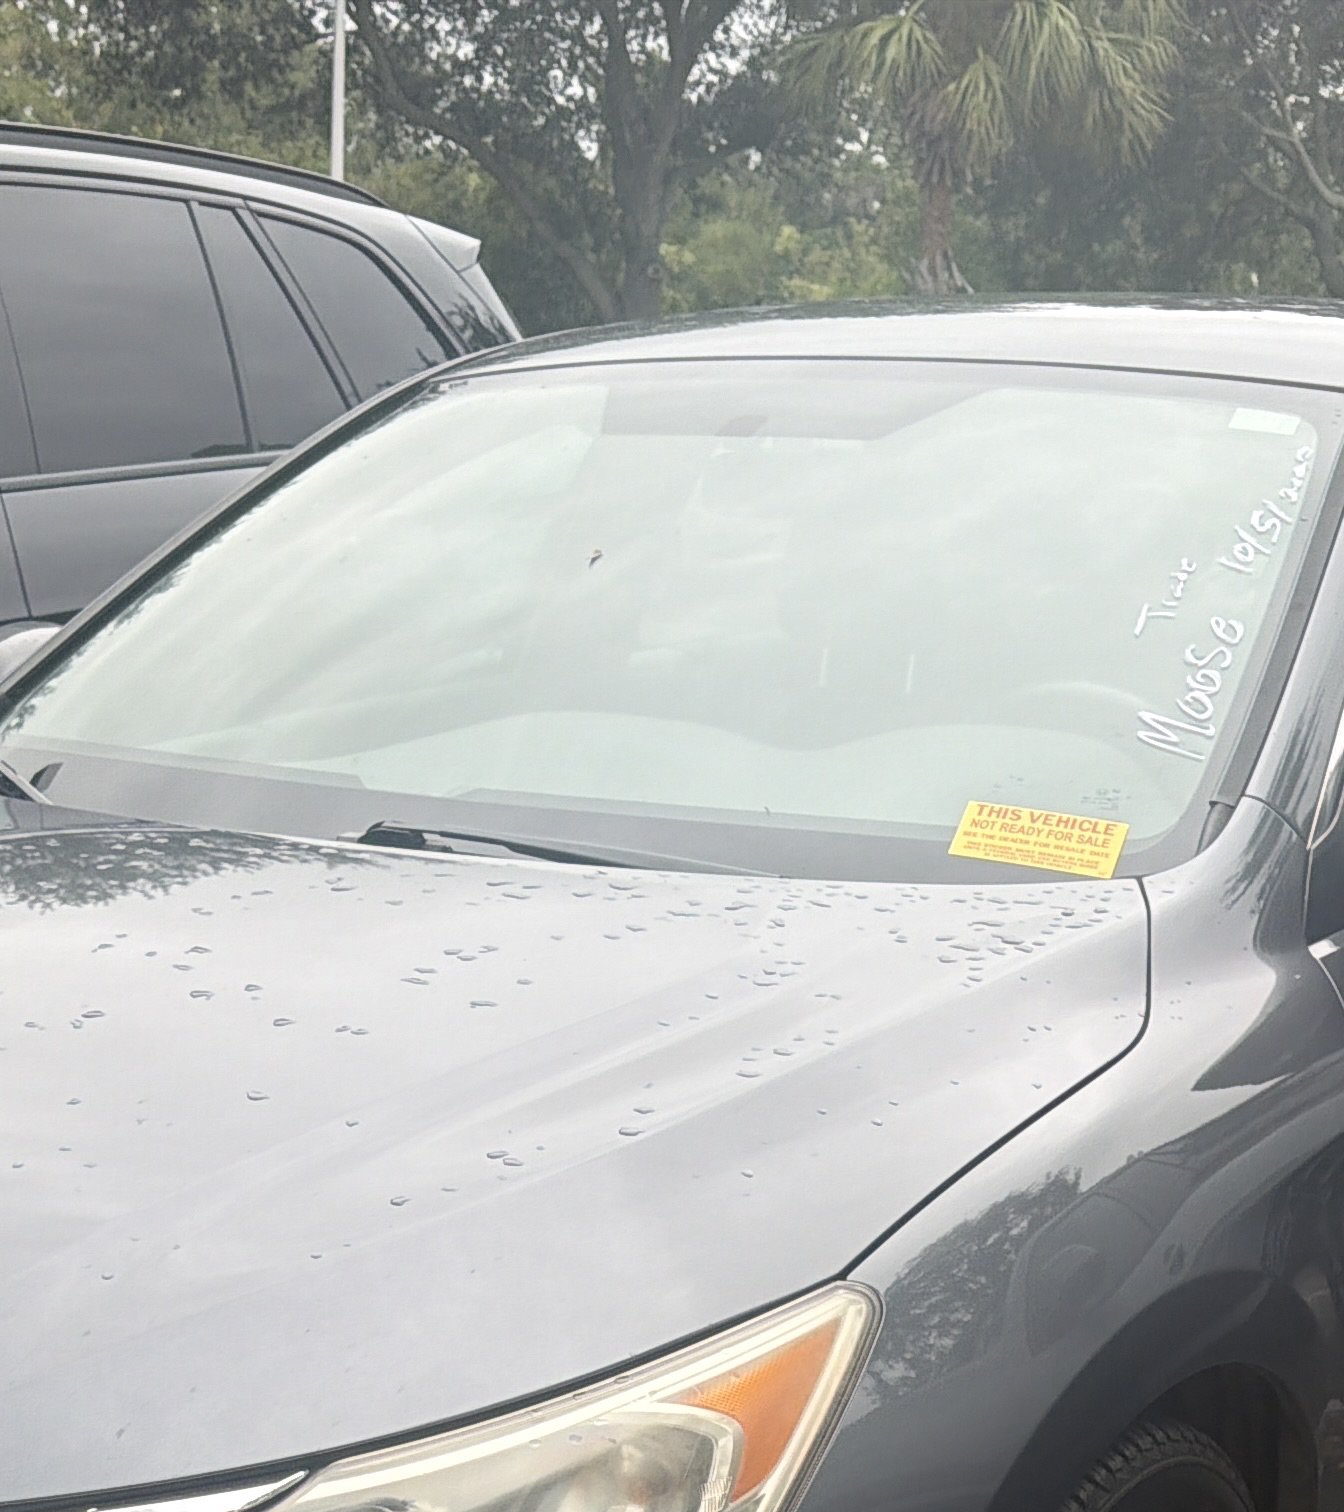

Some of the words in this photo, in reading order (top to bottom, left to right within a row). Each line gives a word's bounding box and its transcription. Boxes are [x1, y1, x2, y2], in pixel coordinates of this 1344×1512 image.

[970, 818, 997, 830] NOT
[999, 822, 1044, 837] READY
[1046, 829, 1073, 843] FOR
[1076, 834, 1111, 849] SALE
[977, 803, 1023, 821] THIS
[1029, 811, 1118, 836] VEHICLE
